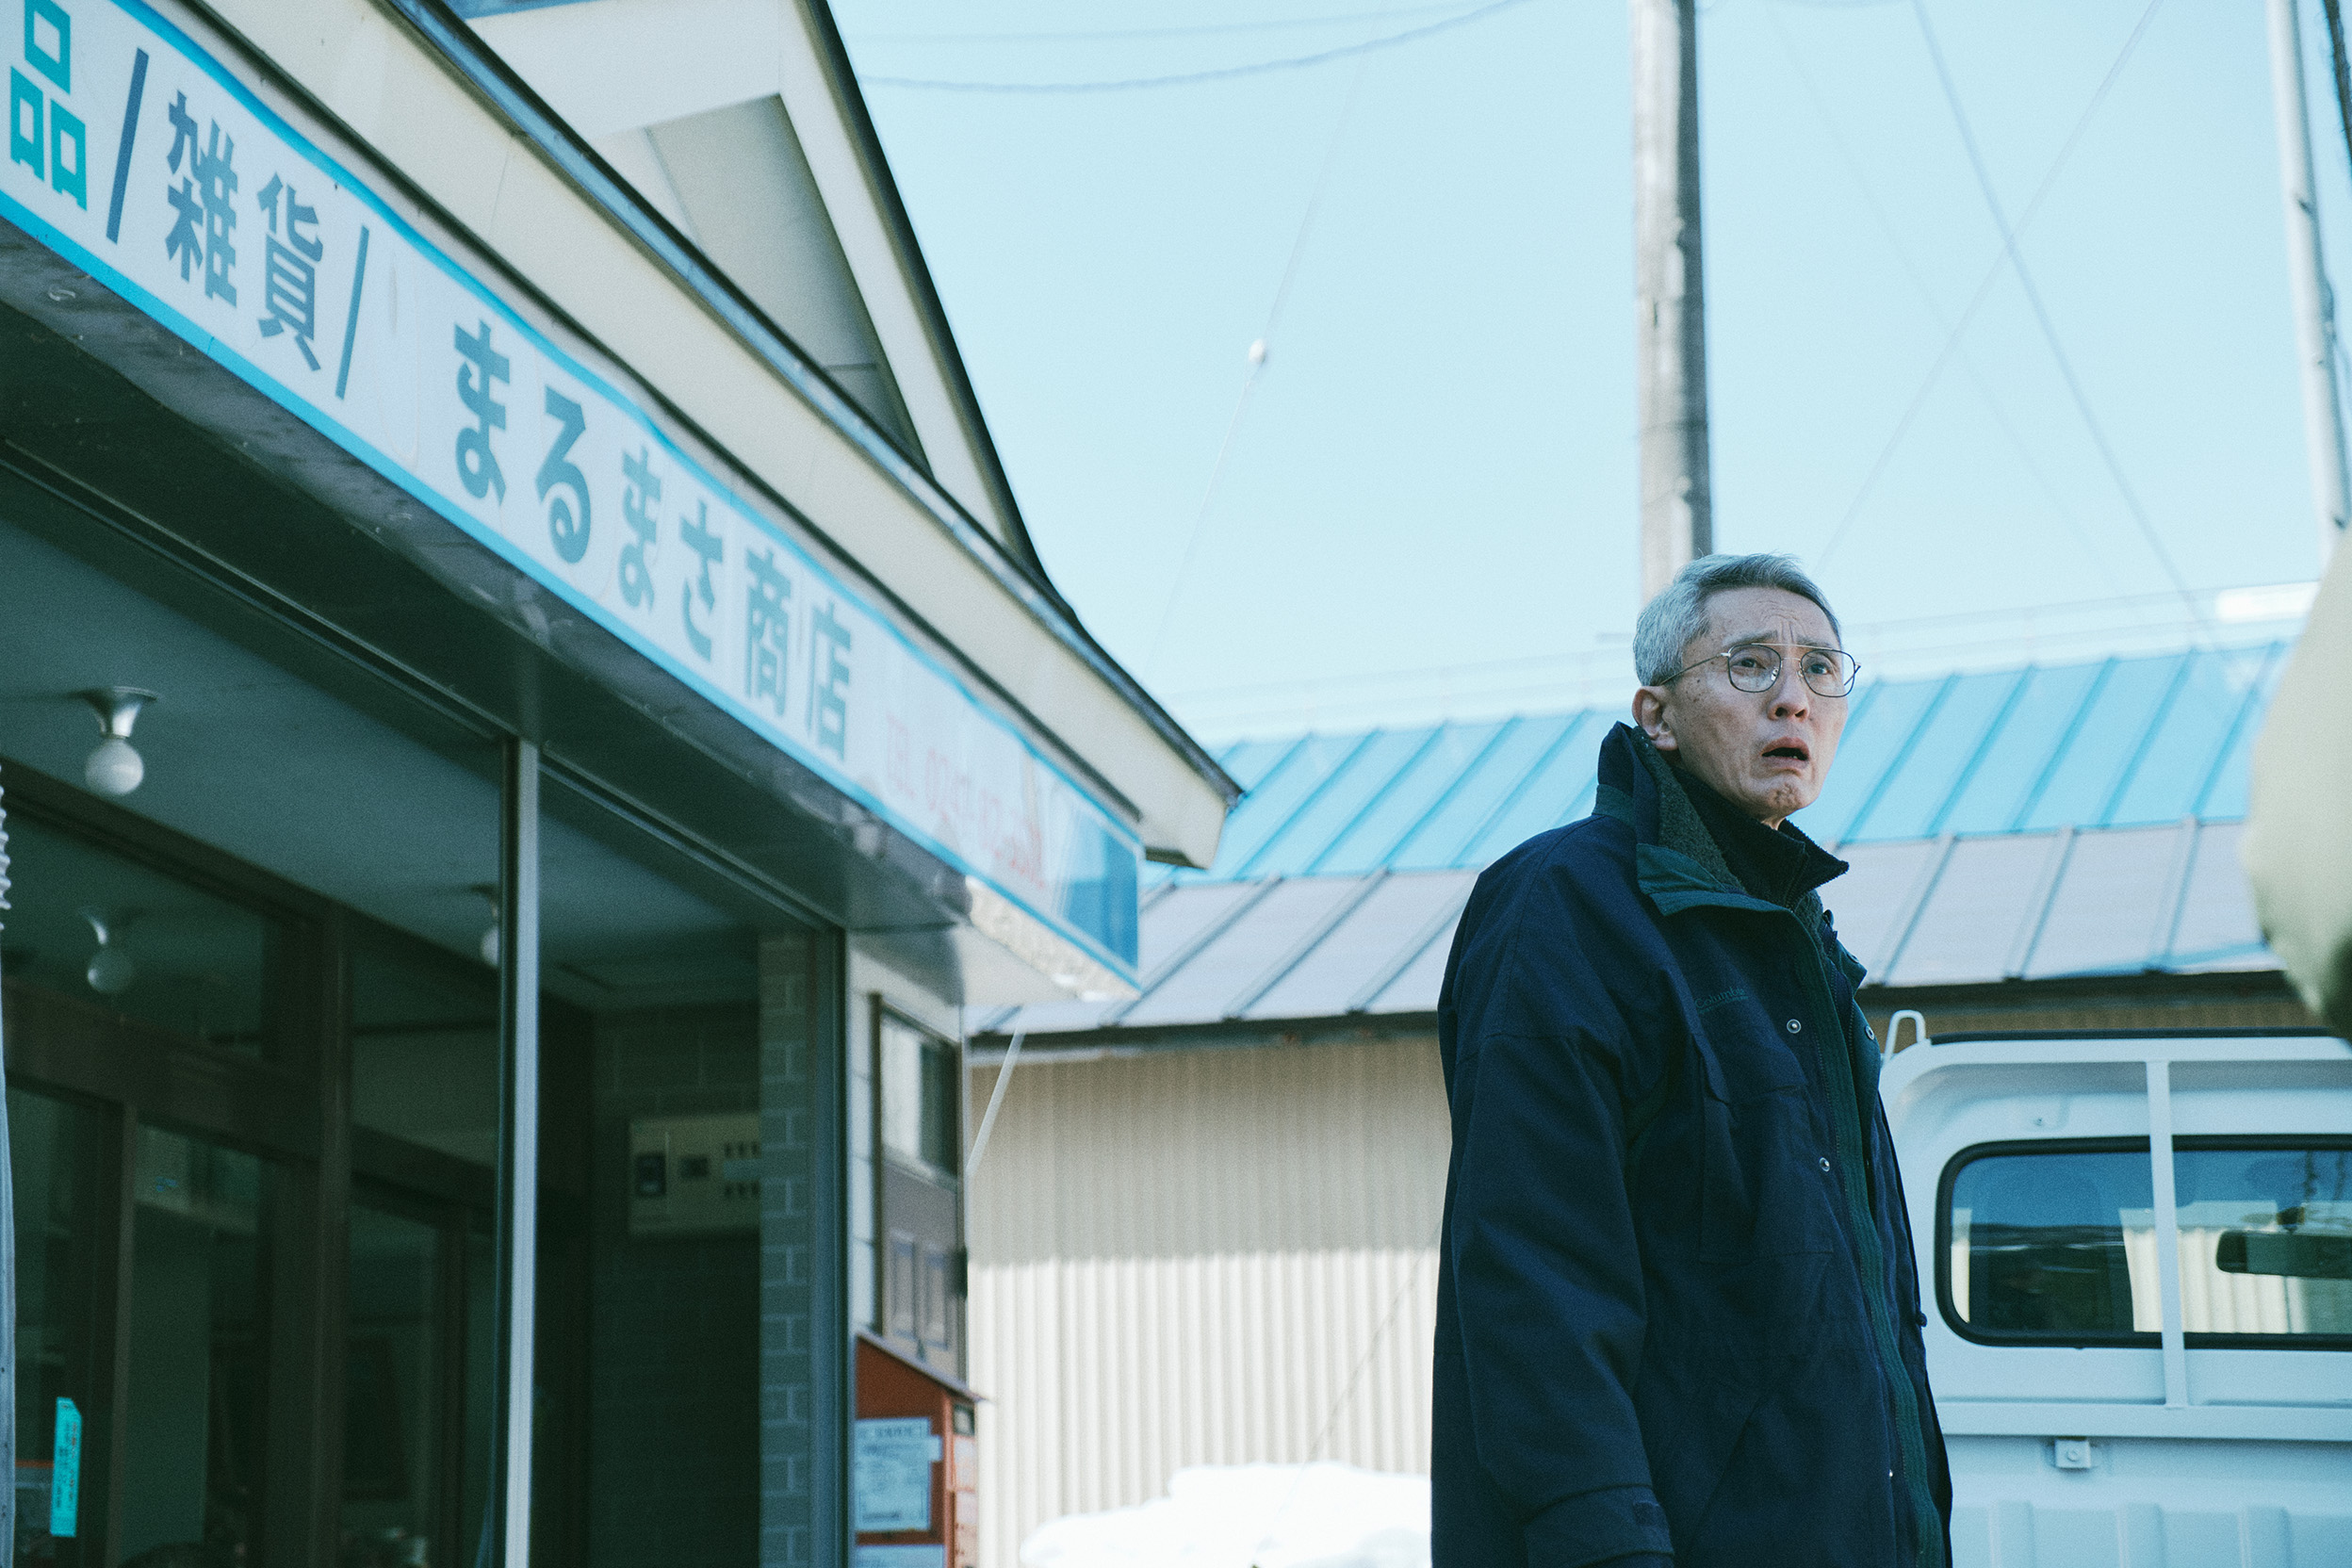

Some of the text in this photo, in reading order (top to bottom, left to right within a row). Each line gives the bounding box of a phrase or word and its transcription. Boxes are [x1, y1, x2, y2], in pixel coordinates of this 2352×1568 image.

[452, 318, 854, 763] まるまさ商店
